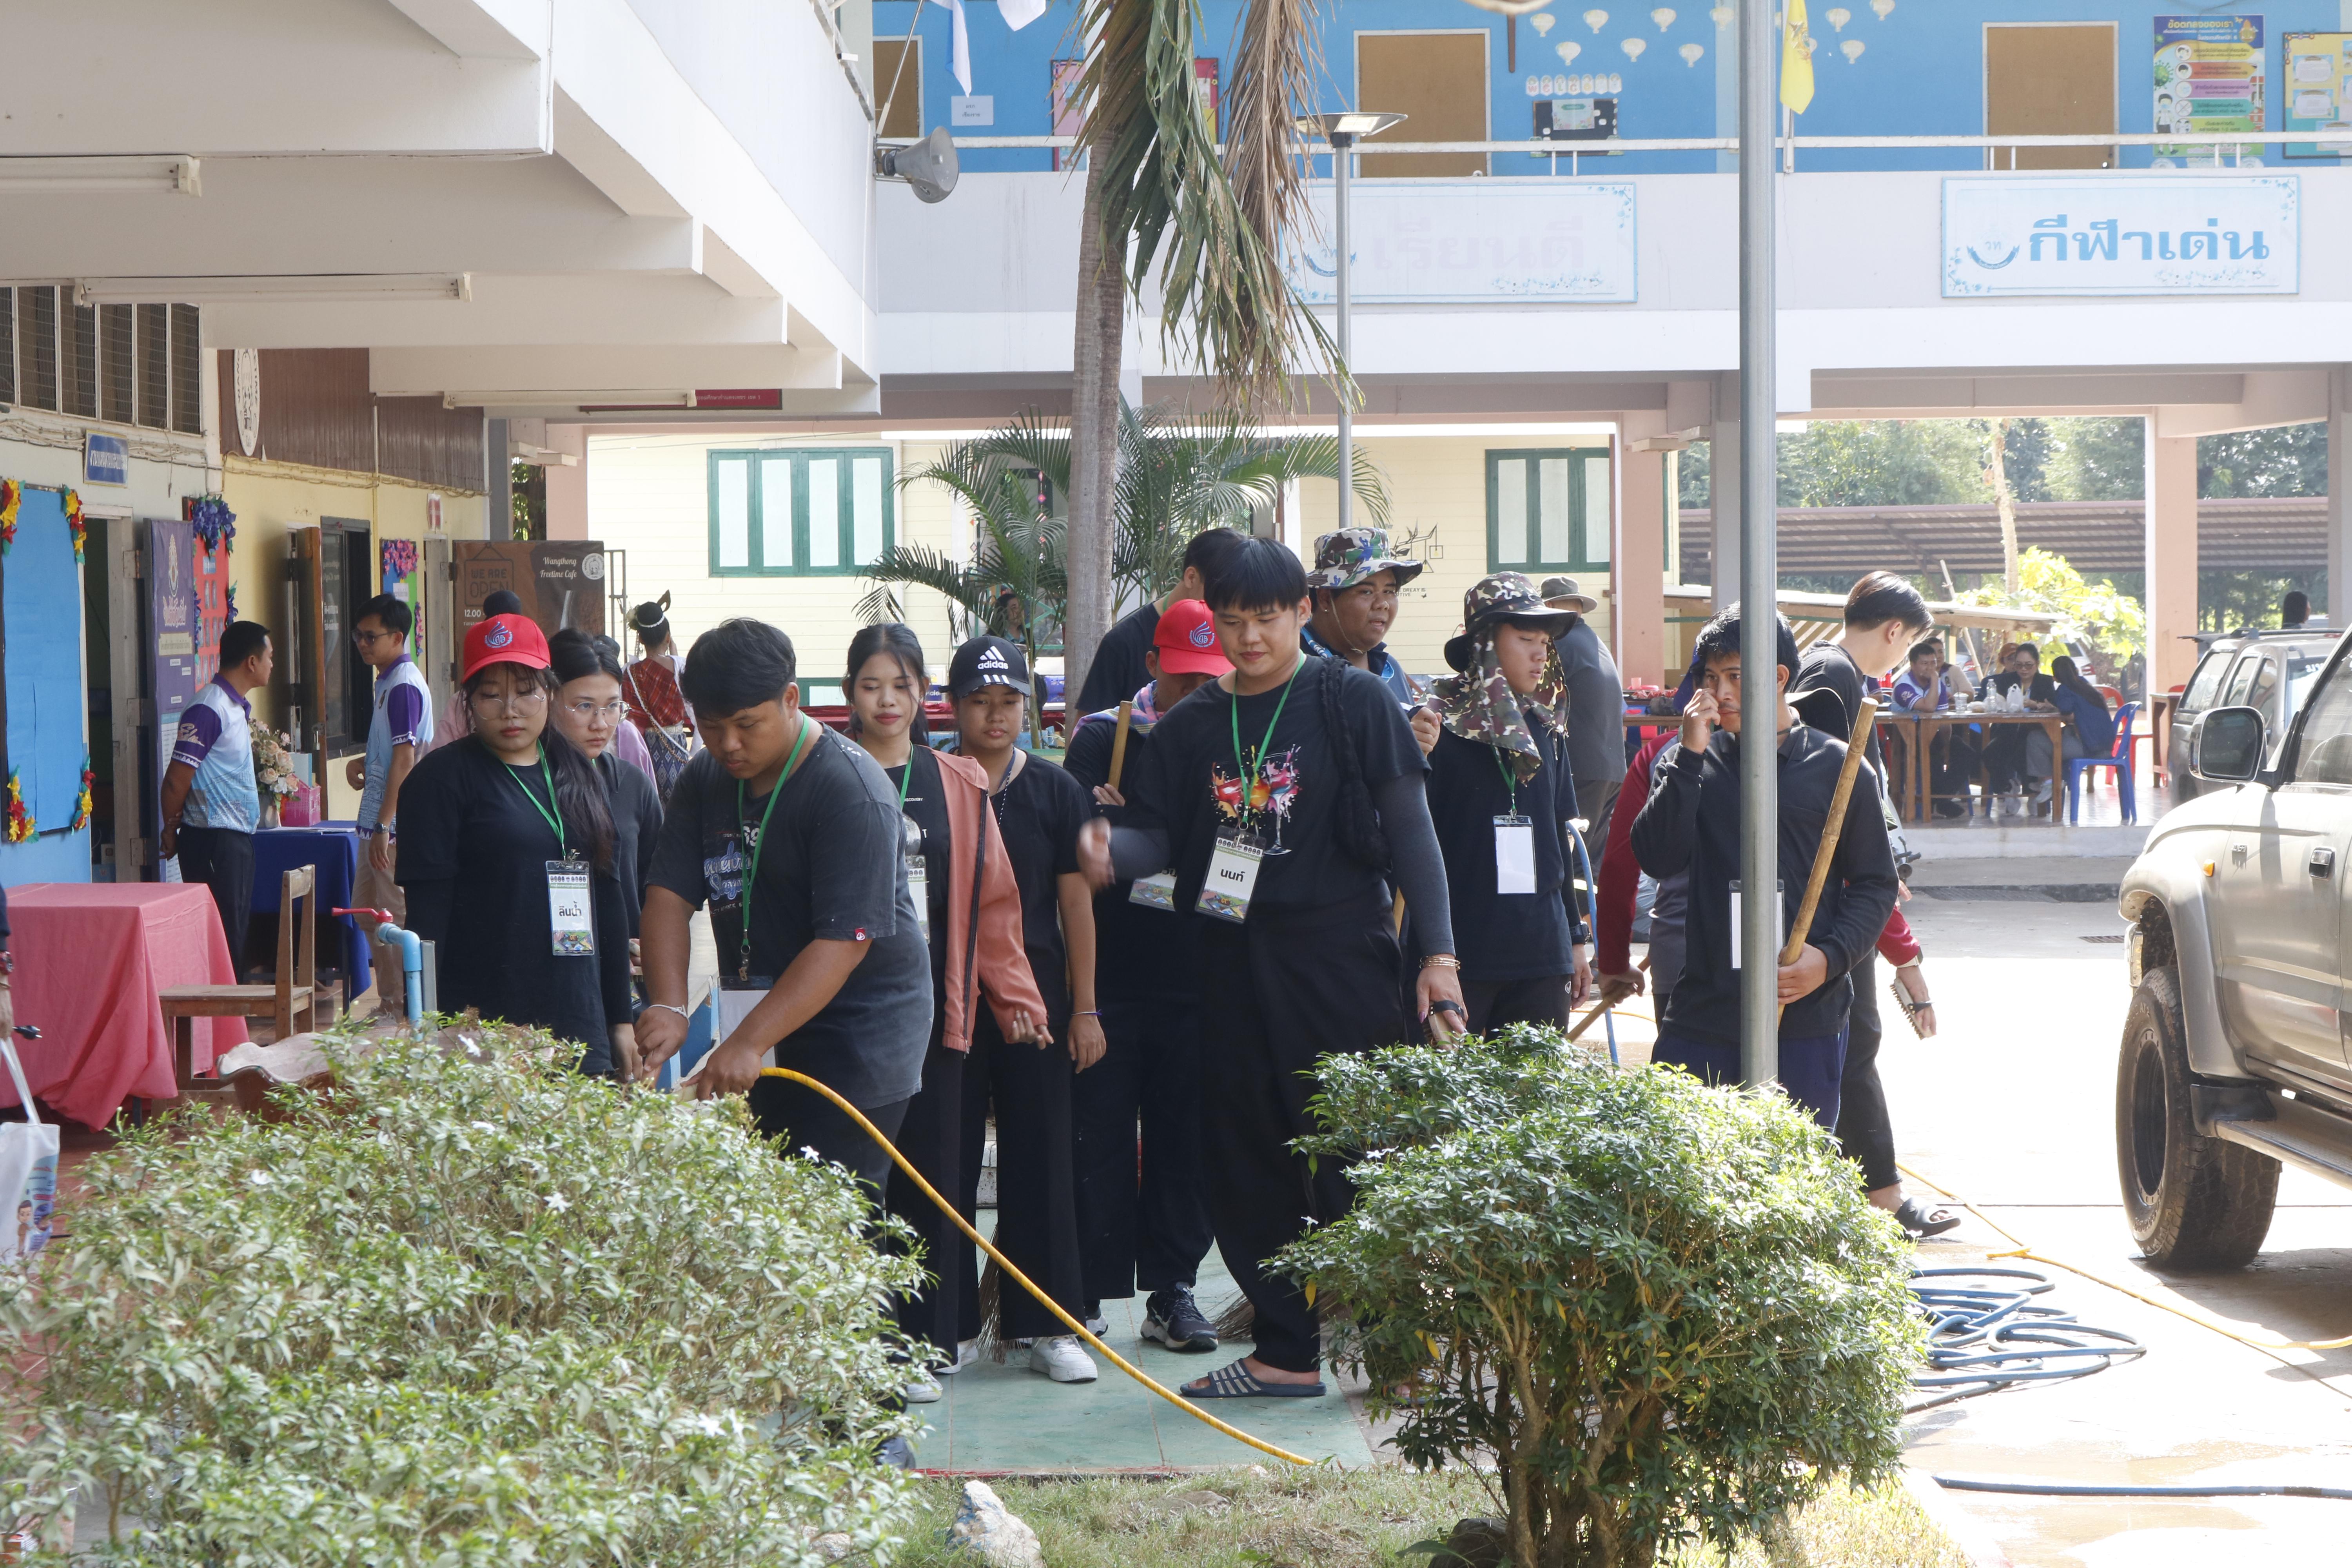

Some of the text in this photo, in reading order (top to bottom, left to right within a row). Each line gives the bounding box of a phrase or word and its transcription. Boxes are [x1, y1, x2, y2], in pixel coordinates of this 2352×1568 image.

[1373, 214, 1584, 269] เรียนดี
[2029, 214, 2269, 262] กีฬาเด่น
[543, 557, 577, 567] Wangthong
[471, 569, 507, 579] WE ARE
[540, 570, 577, 580] Freetime Cafe
[464, 609, 481, 617] 12.00
[978, 661, 1009, 670] adidas
[1220, 869, 1245, 882] นนท์
